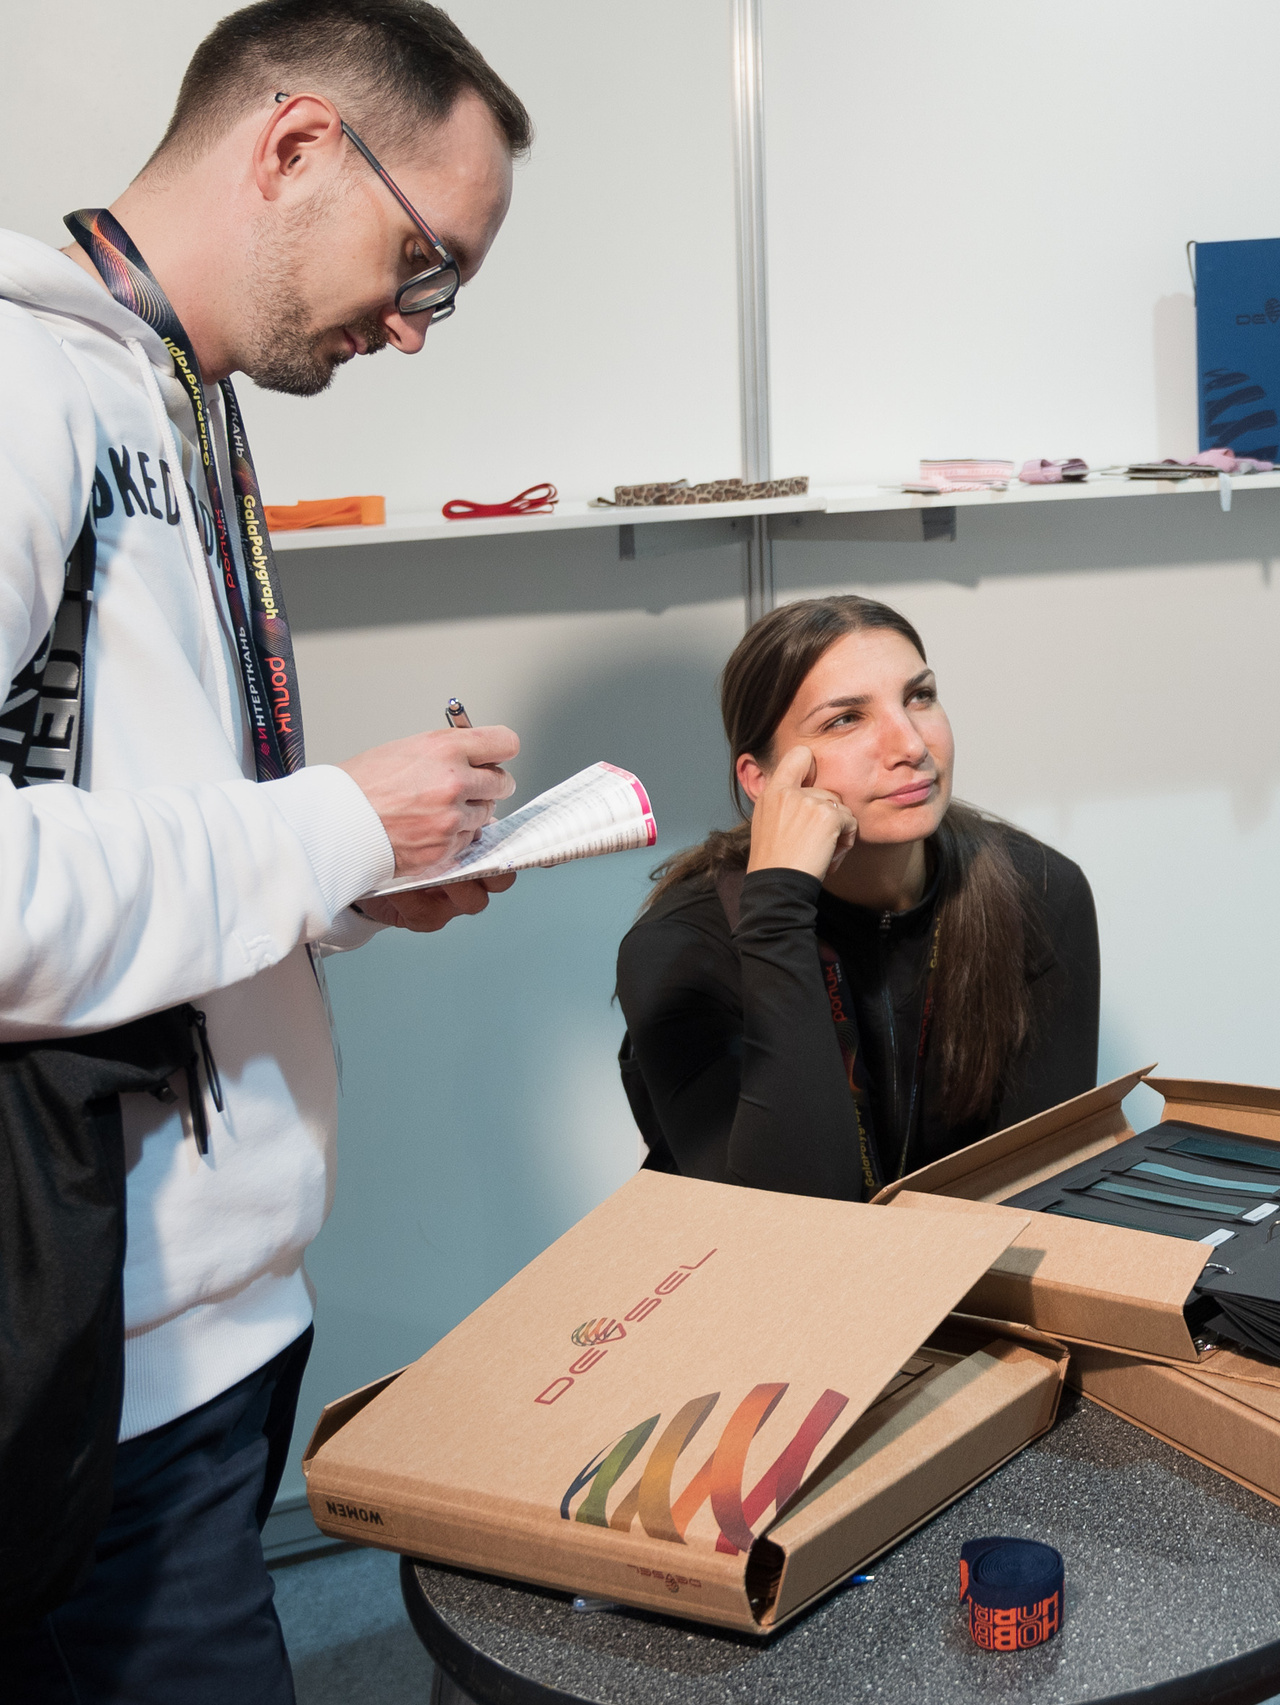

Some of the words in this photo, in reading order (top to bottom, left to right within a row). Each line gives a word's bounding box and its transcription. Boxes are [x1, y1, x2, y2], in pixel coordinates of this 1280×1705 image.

[243, 494, 279, 620] GalaPolygraph
[238, 626, 267, 740] ИНТЕРТКАНЬ
[534, 1248, 718, 1405] DEVSEL
[325, 1500, 384, 1526] WOMEN
